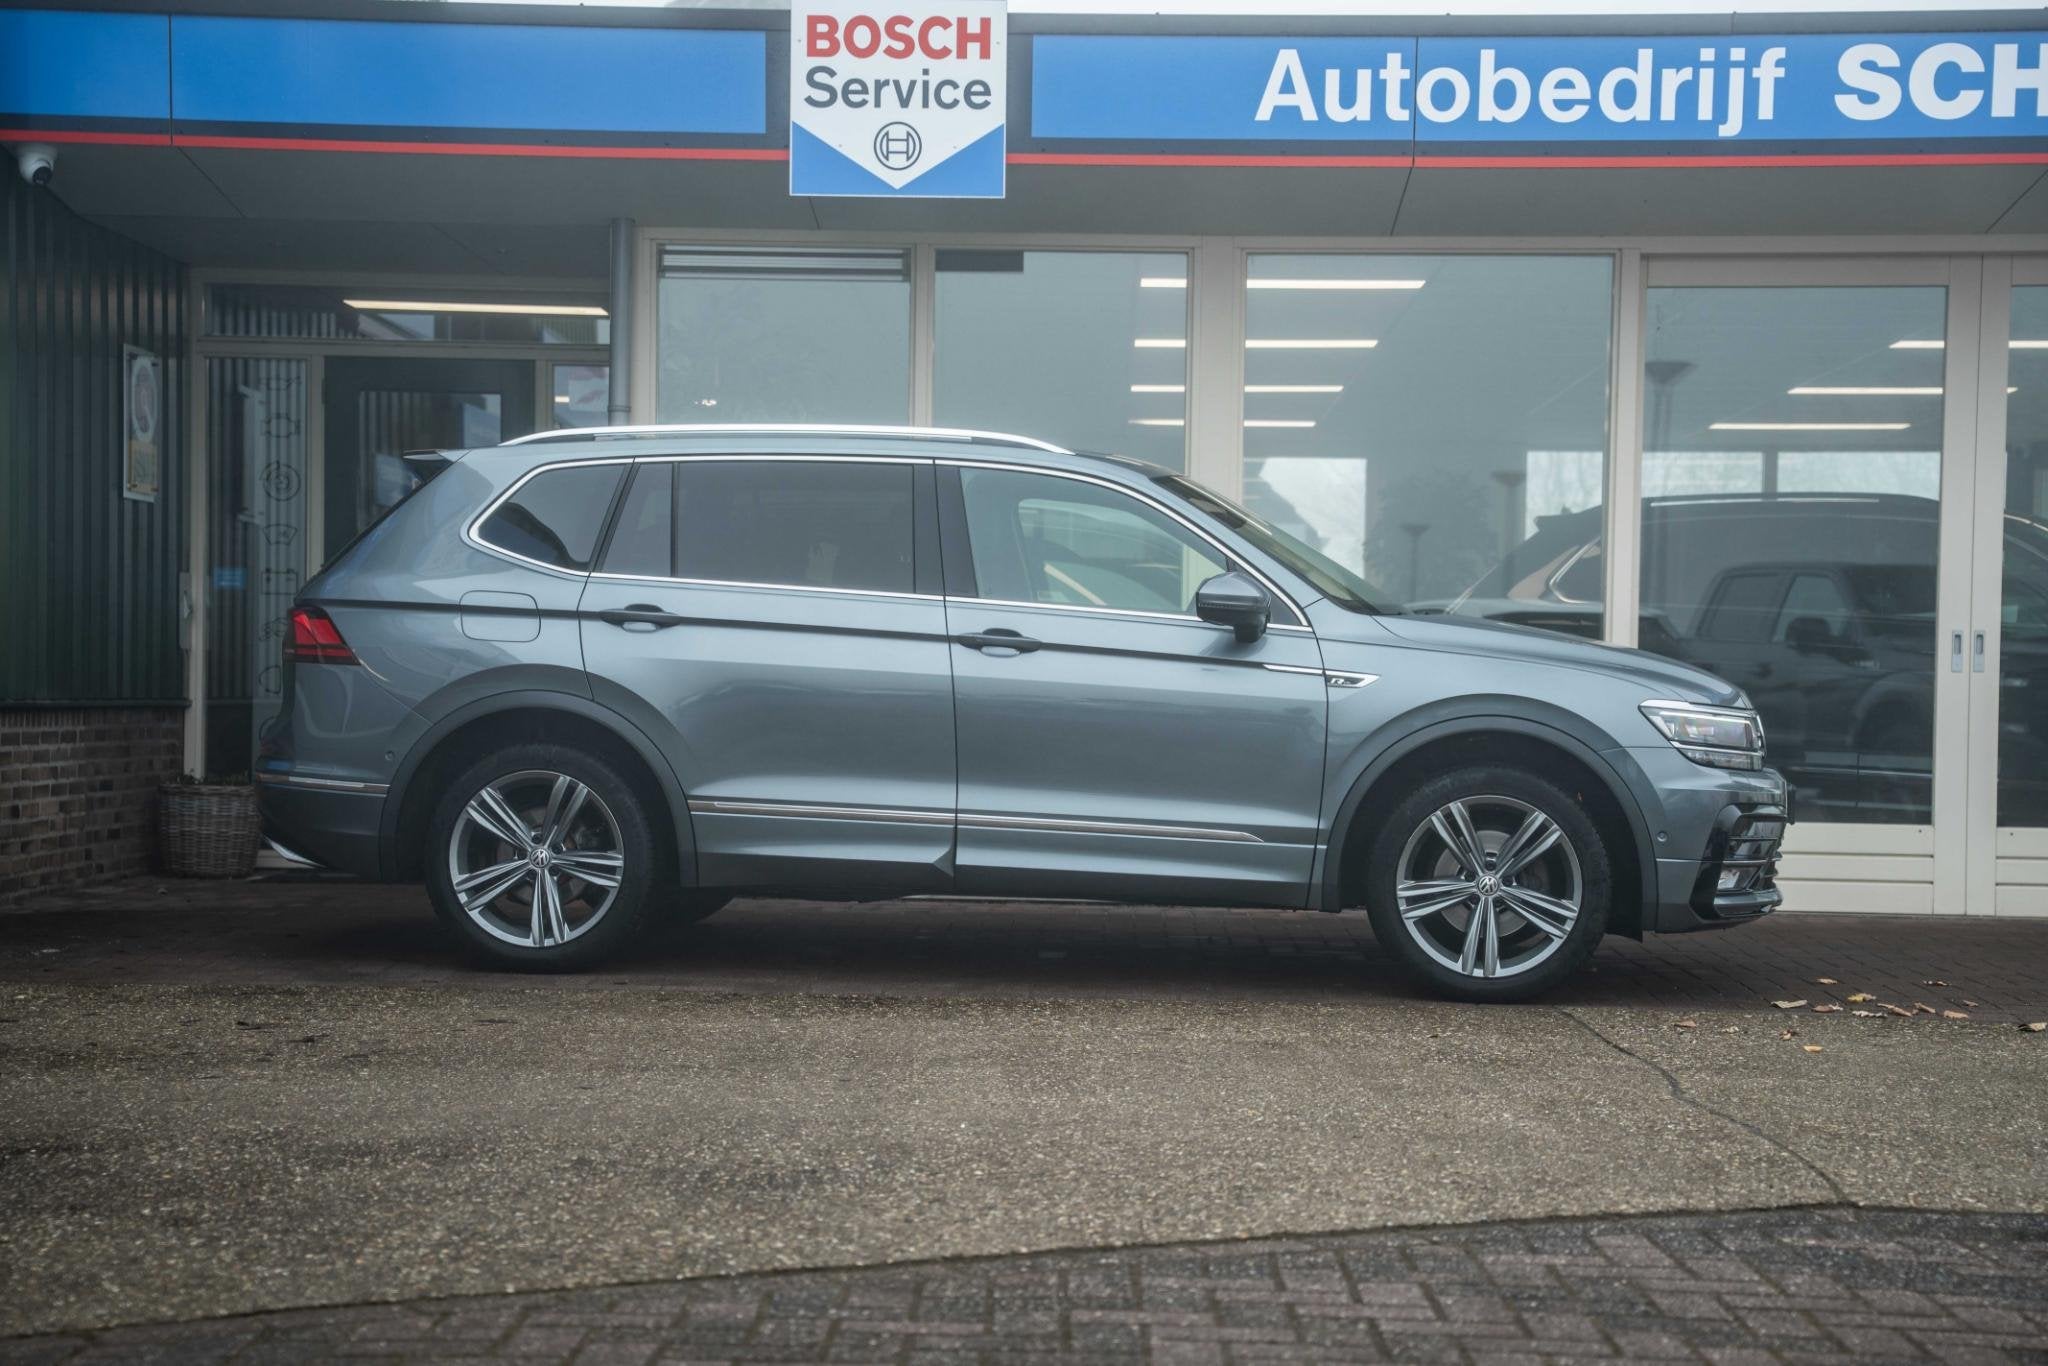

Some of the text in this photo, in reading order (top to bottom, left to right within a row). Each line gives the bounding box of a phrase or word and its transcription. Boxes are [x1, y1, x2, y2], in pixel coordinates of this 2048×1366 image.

[806, 15, 991, 60] BOSCH
[804, 65, 992, 110] Service
[1254, 42, 2048, 137] Autobedrijf SCH
